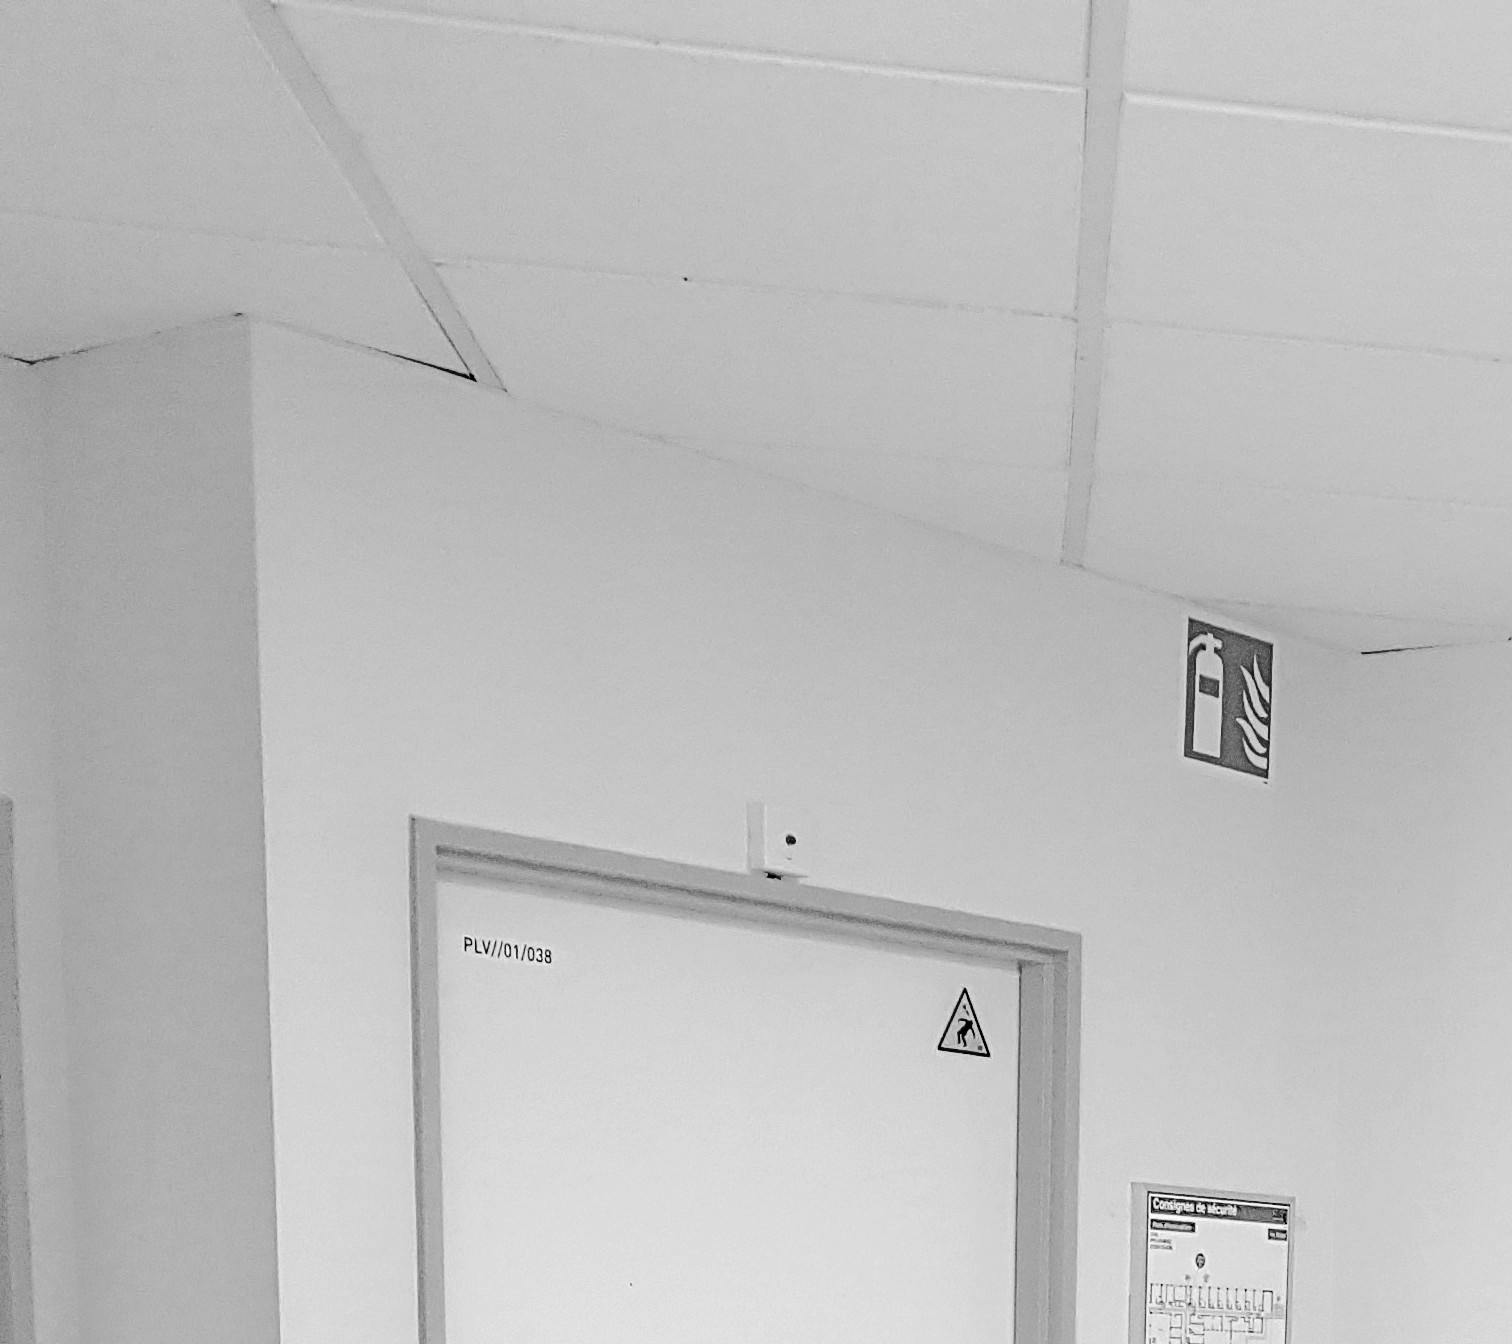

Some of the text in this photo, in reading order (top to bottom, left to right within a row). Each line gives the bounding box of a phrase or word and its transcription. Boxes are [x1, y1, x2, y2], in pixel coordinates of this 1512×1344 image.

[463, 936, 553, 964] PLV//01/038
[1152, 1197, 1194, 1214] Consignes
[1195, 1203, 1207, 1214] de
